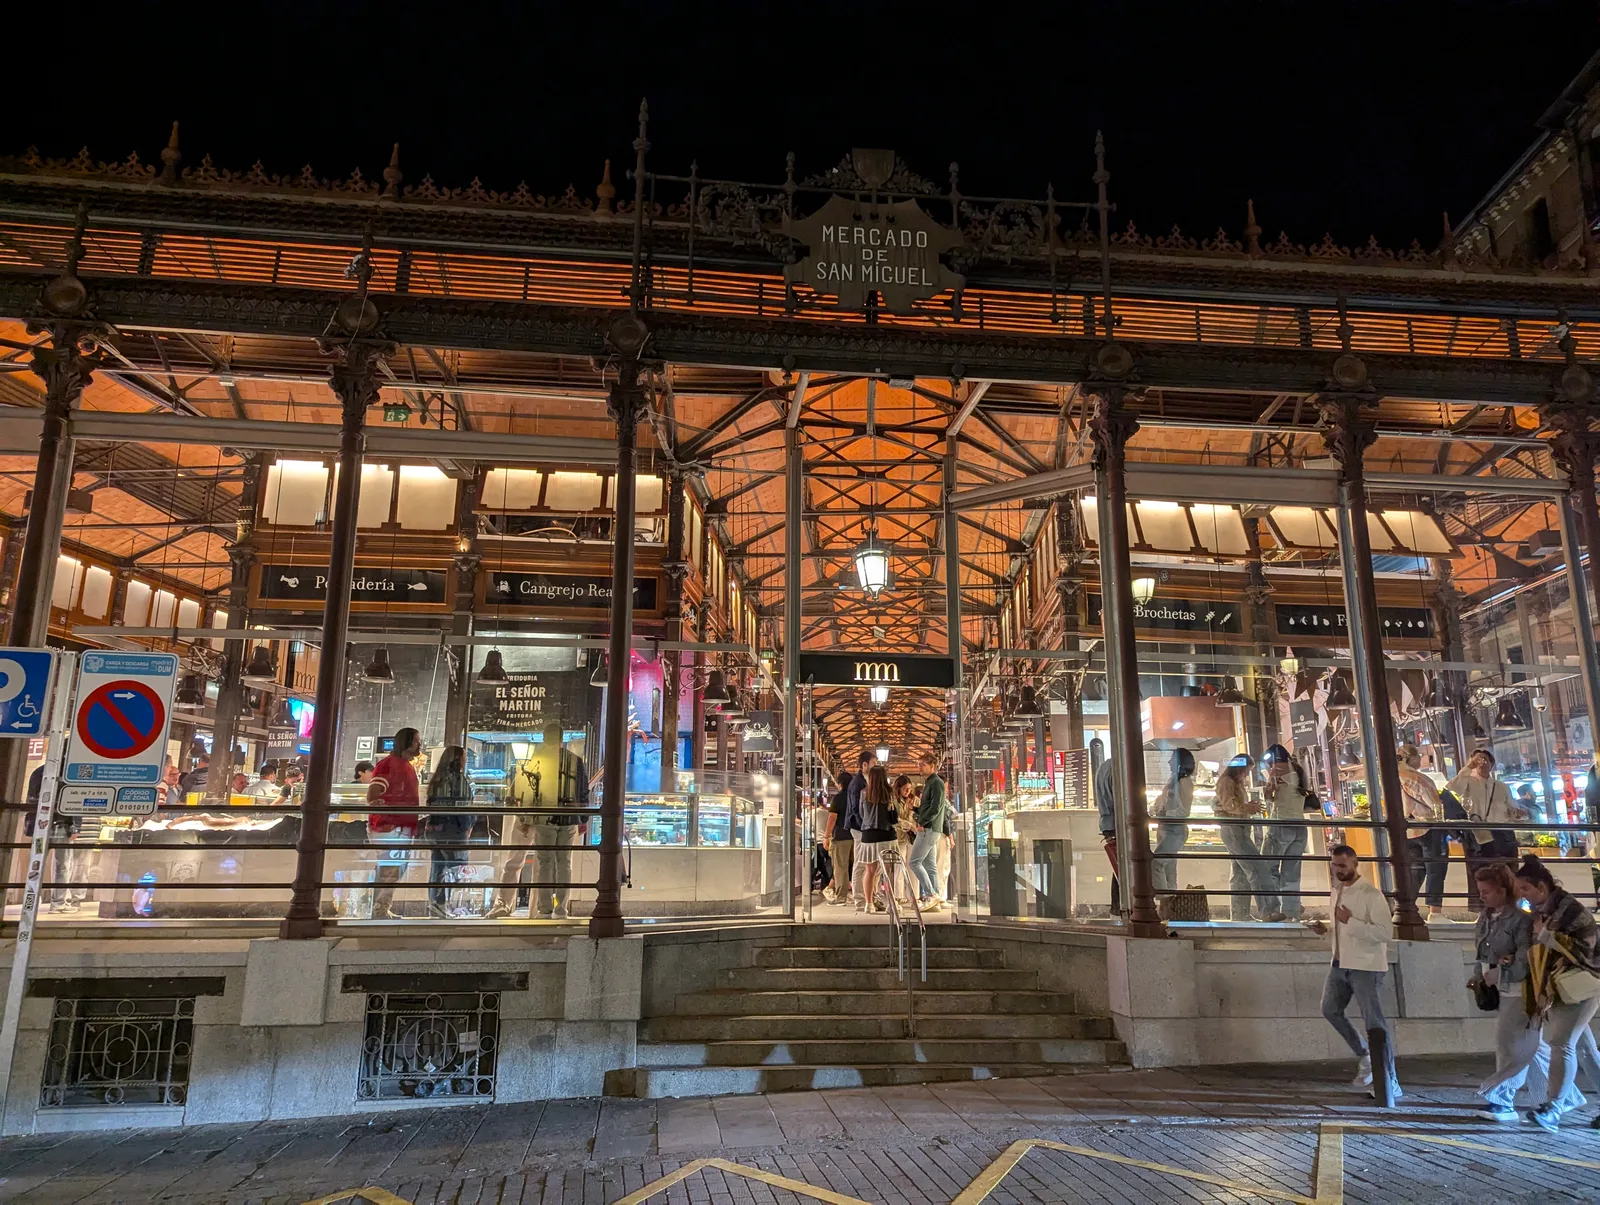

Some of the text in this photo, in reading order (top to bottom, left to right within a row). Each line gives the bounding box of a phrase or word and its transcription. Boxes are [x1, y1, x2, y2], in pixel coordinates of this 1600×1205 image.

[822, 225, 928, 248] MERCADO
[862, 249, 888, 262] DE
[816, 262, 933, 286] SAN MIGUEL
[314, 575, 395, 591] Padería
[520, 580, 613, 600] Cangrejo Rea
[1135, 605, 1196, 621] Brochetas
[495, 684, 546, 698] EL SEÑOR
[499, 700, 542, 711] MARTIN
[515, 718, 544, 728] MERCADO
[268, 730, 298, 740] EL SEÑOR
